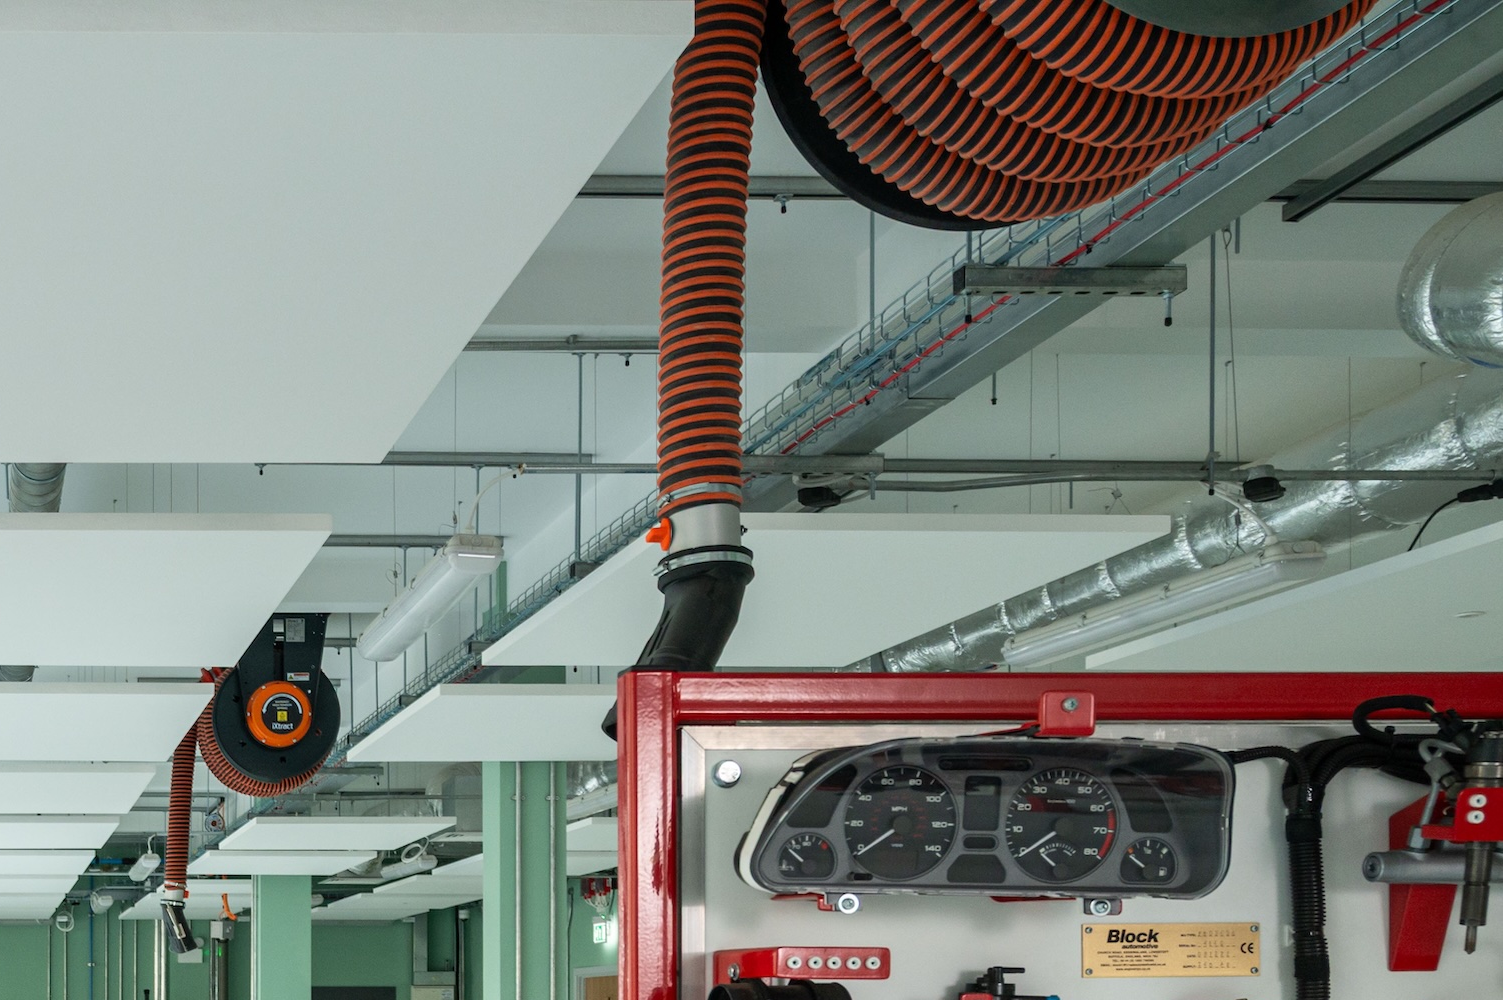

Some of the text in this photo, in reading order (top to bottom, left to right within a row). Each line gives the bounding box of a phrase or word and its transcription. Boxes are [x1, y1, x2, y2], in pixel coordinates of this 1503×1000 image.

[1033, 786, 1047, 794] 30
[1017, 803, 1032, 811] 20
[1012, 825, 1023, 833] 10
[1107, 929, 1159, 943] Block
